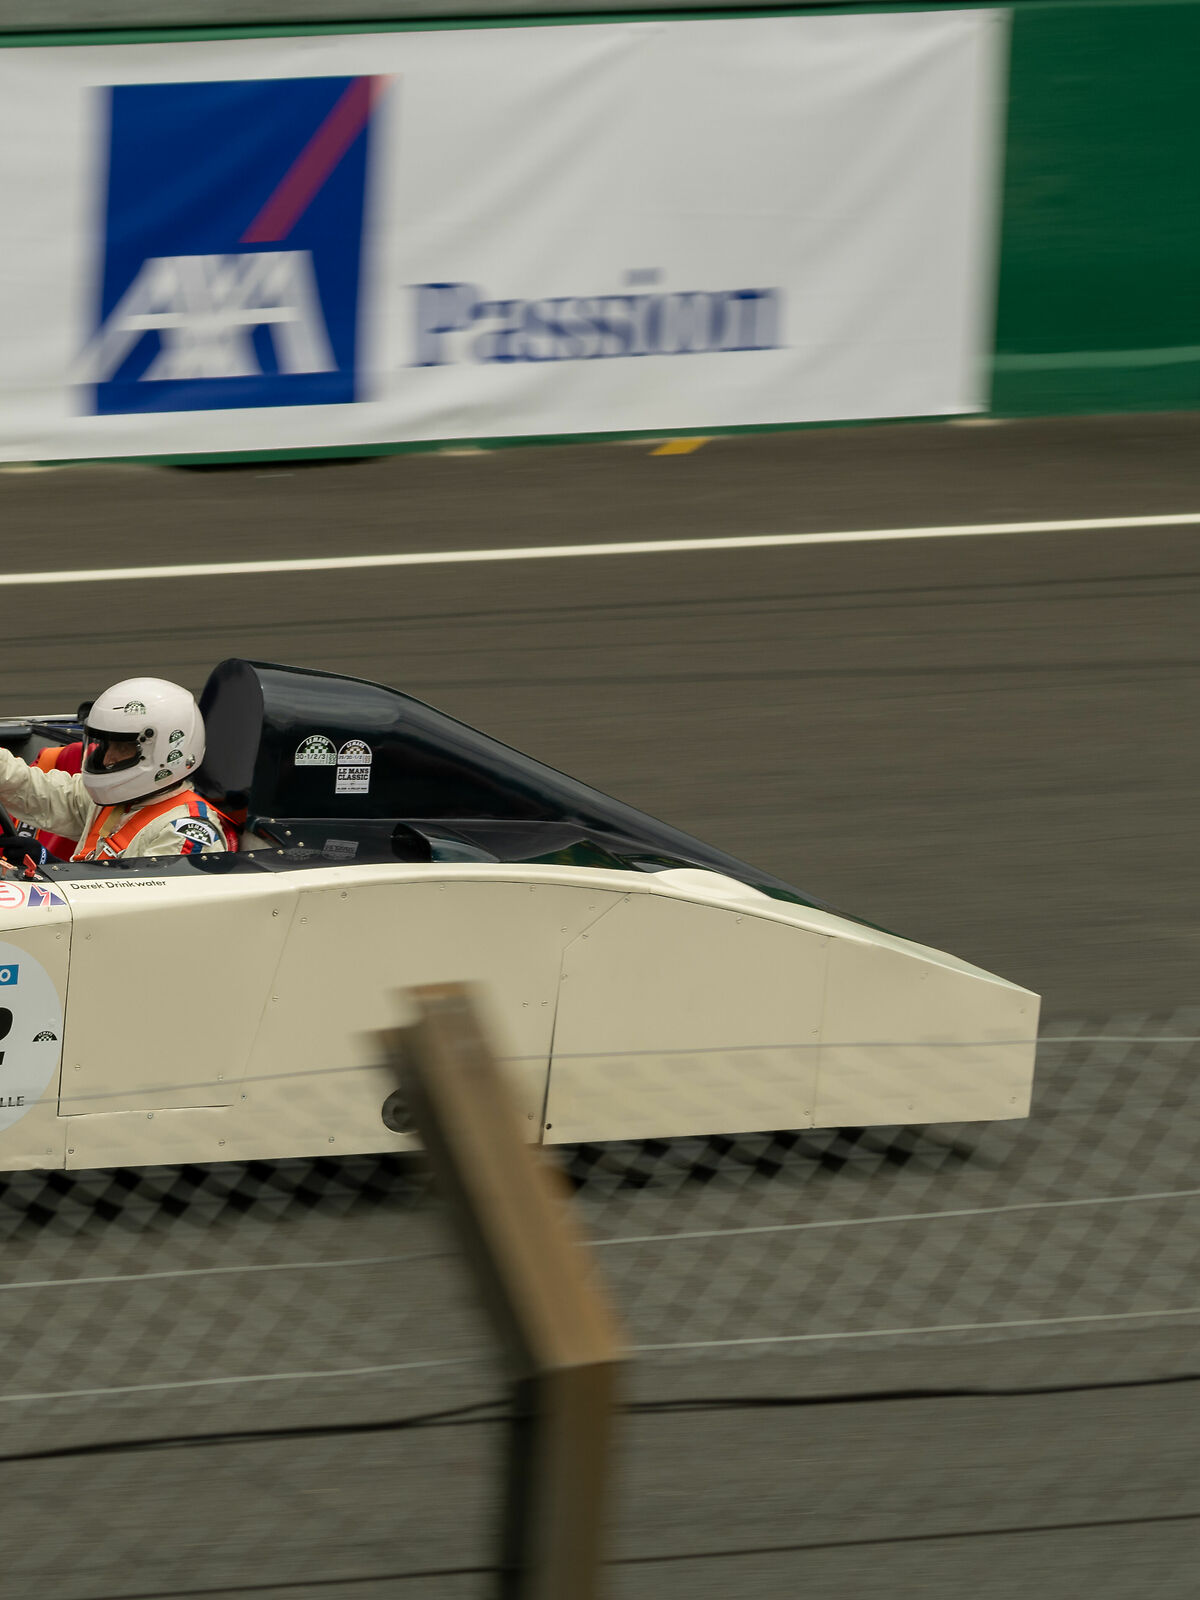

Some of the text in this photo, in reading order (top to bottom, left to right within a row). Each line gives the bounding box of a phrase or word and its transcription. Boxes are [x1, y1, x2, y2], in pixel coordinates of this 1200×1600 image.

[81, 249, 339, 384] AXA
[406, 268, 786, 368] Passion
[105, 880, 166, 889] Drinkwater
